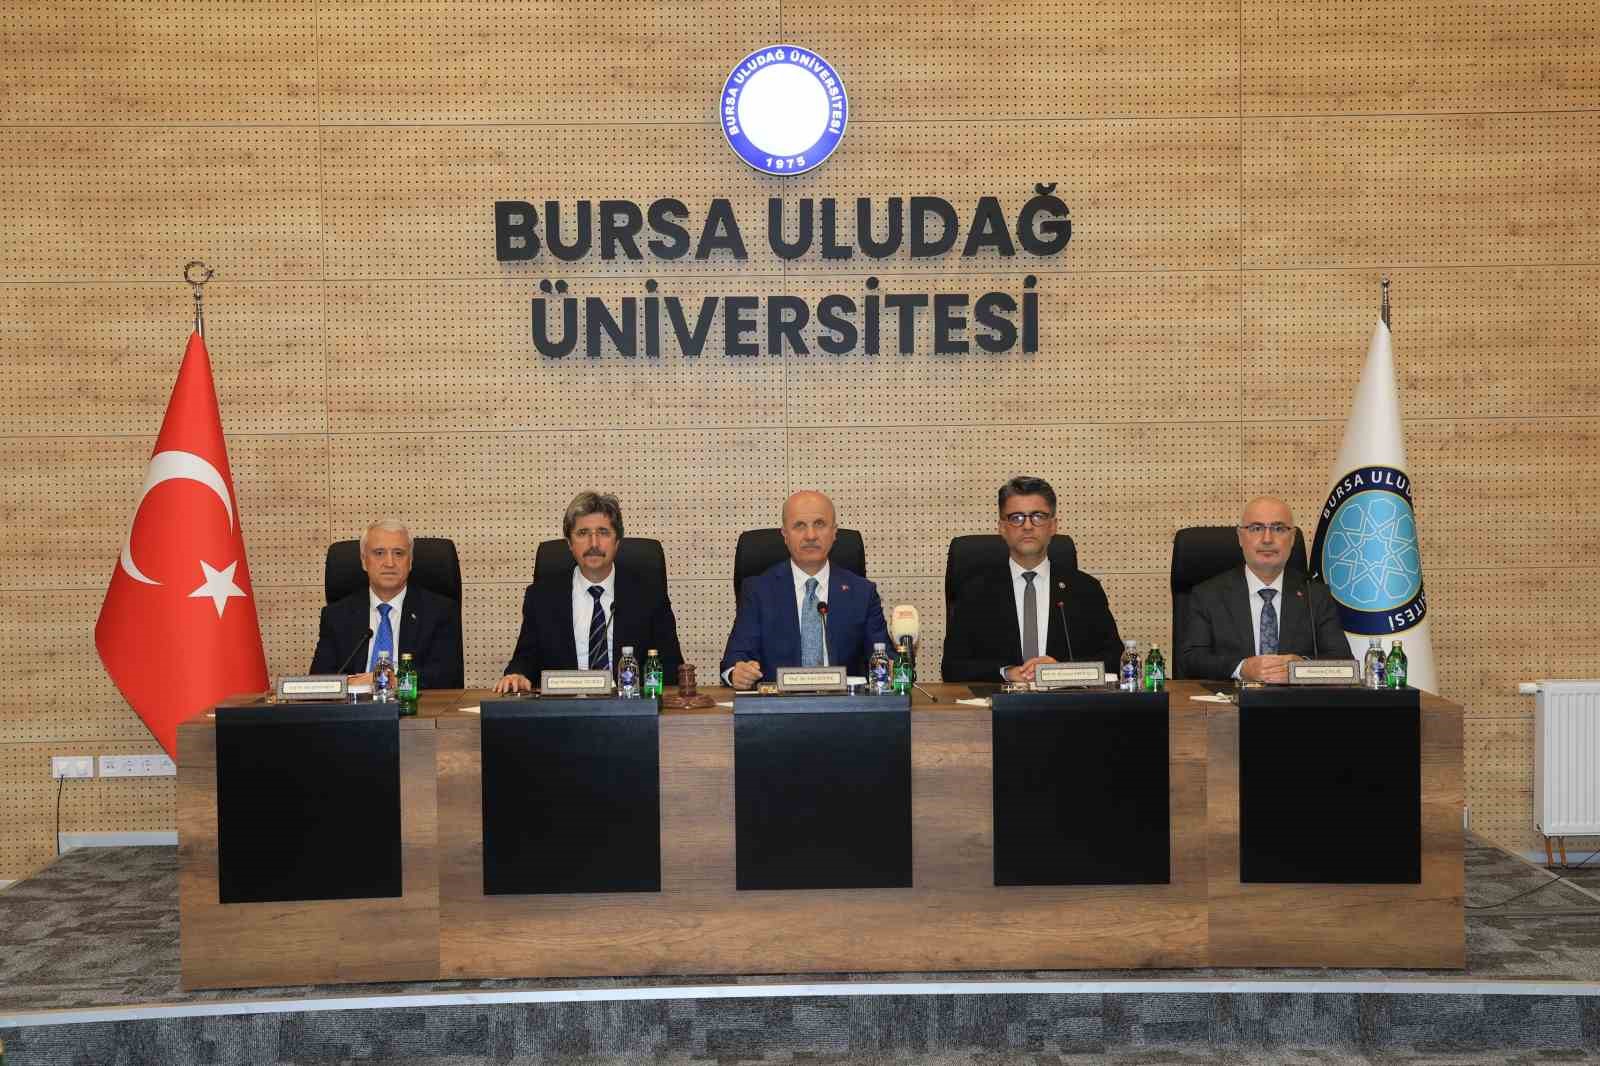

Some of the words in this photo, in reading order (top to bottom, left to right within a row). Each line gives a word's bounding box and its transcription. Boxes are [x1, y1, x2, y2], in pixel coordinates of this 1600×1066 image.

[725, 87, 740, 135] BURSA
[734, 49, 785, 84] ULUDAĞ
[790, 50, 843, 134] ÜNİVERSİTESİ
[766, 156, 806, 169] 1975
[495, 198, 748, 262] BURSA
[768, 182, 1072, 259] ULUDAĞ
[531, 275, 1038, 358] ÜNİVERSİTESİ
[1322, 475, 1364, 519] BURSA
